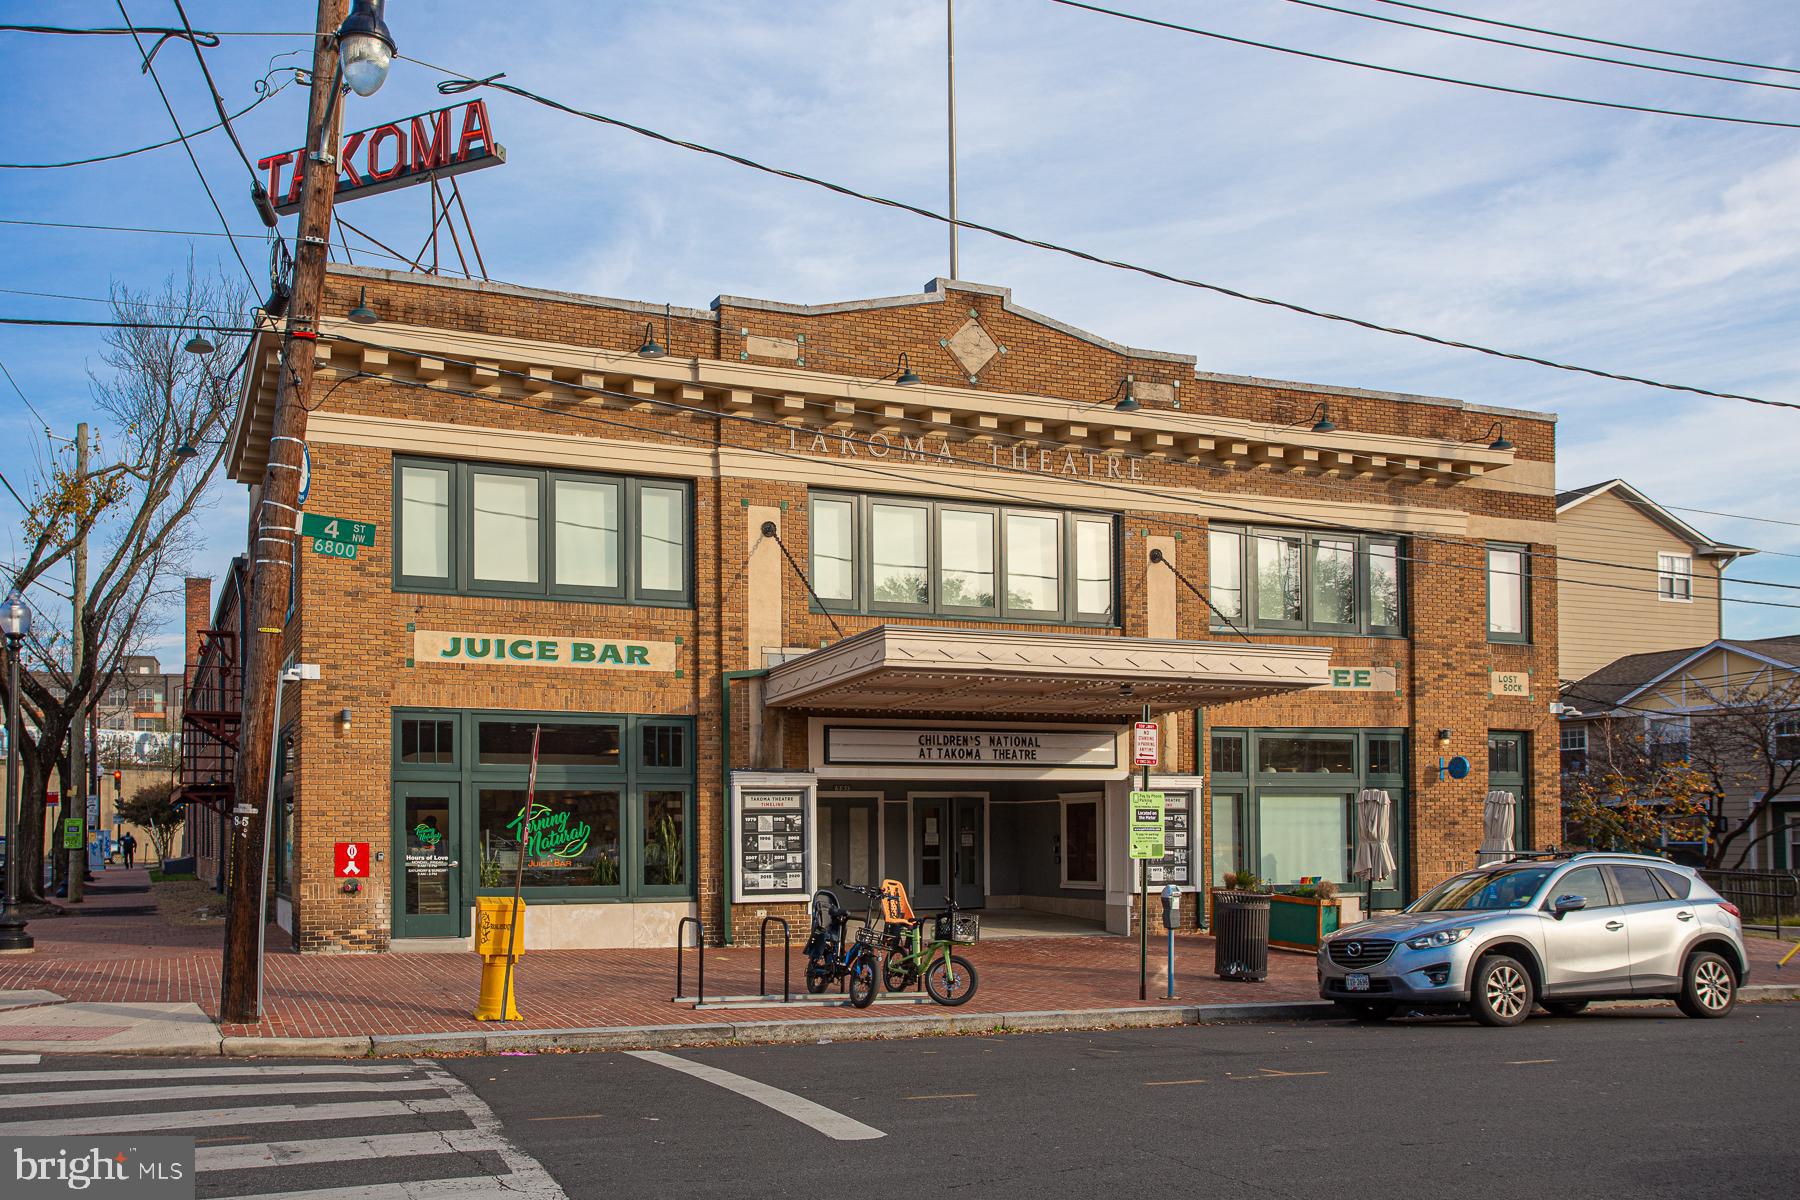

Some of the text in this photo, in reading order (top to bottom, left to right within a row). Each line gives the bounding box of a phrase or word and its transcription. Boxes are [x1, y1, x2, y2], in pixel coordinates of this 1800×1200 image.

[785, 422, 1143, 480] TAKOMA THEATRE
[324, 520, 367, 539] 4 ST
[352, 534, 366, 543] NW
[314, 539, 355, 558] 6800
[440, 637, 651, 666] JUICE BAR
[1498, 675, 1517, 684] LOST
[1503, 683, 1522, 692] SOCK
[918, 735, 1041, 748] CHILDREN'S NATIONAL
[919, 748, 1037, 760] AT TAKOMA THEATRE
[528, 820, 591, 857] Natural
[553, 858, 573, 867] BAR
